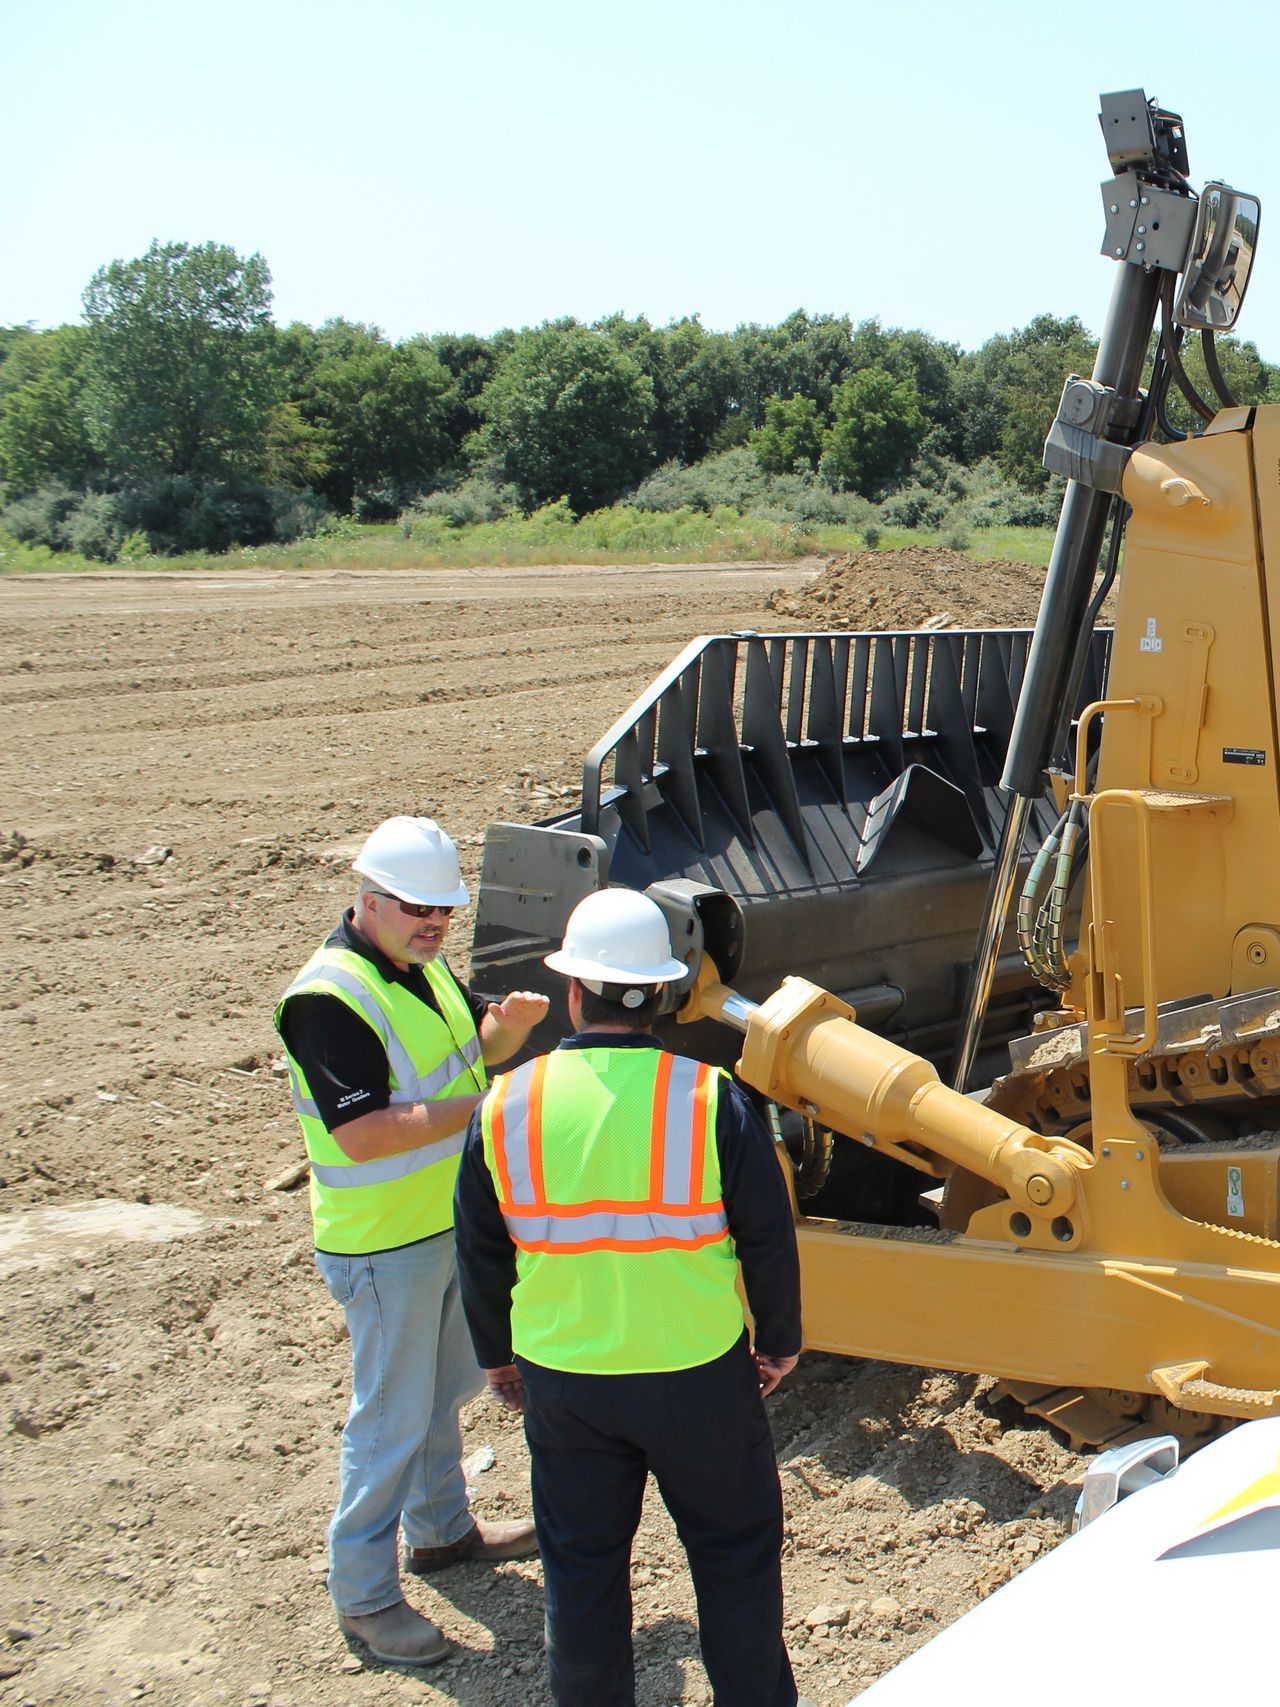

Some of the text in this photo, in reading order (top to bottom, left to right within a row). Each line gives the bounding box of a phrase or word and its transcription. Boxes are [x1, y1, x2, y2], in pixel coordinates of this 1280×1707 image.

[337, 1092, 371, 1109] Motor Graders
[345, 1091, 360, 1101] Series
